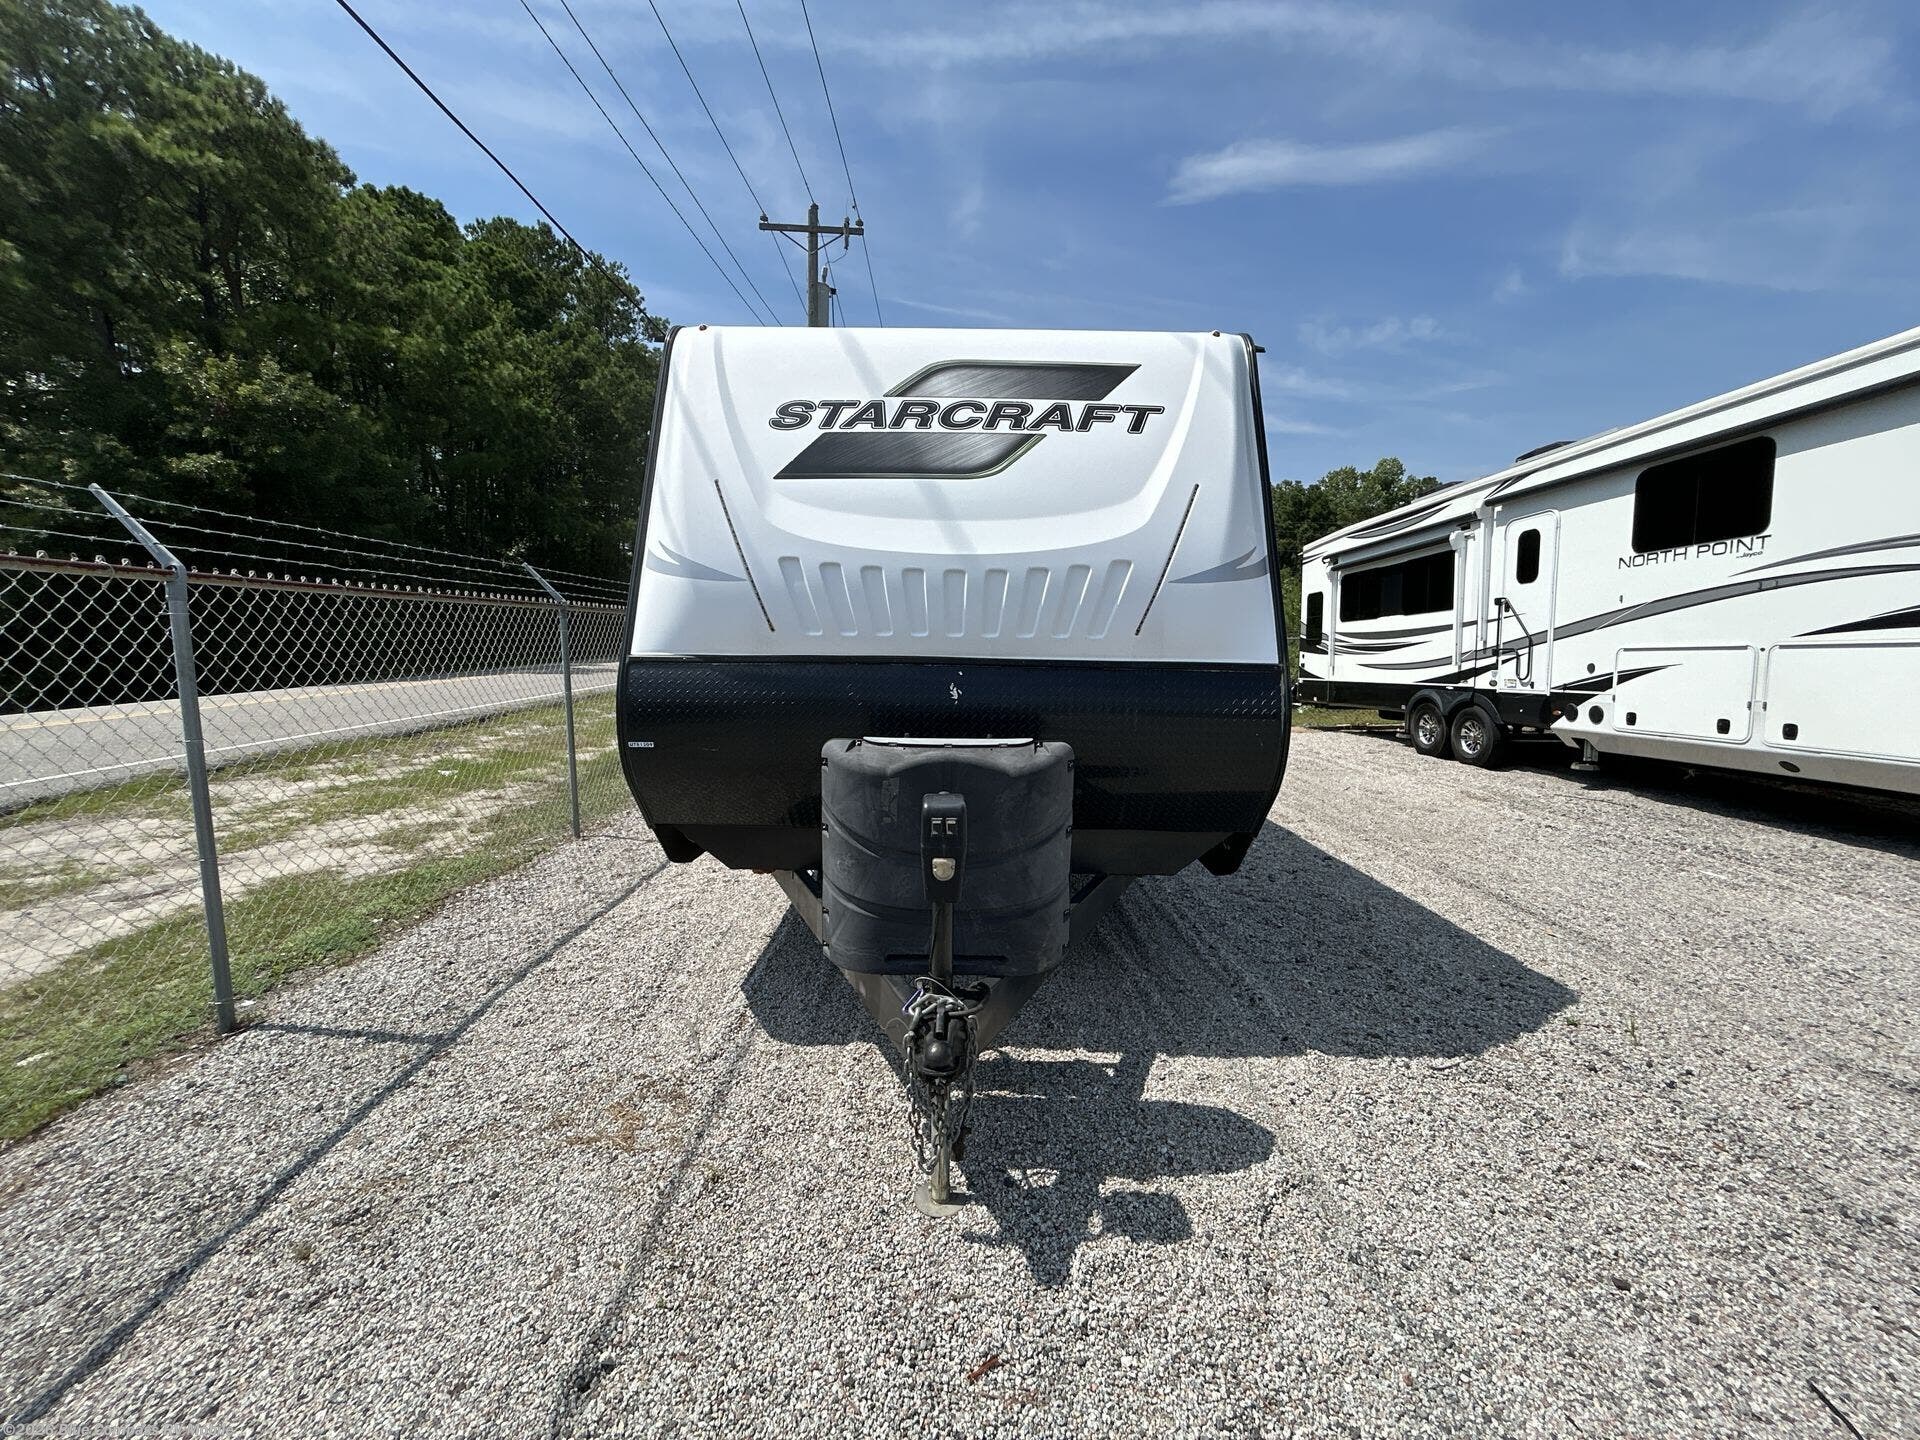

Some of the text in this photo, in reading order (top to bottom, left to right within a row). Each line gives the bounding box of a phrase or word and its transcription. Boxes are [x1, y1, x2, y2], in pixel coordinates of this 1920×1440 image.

[768, 399, 1165, 434] STARCRAFT
[1618, 534, 1772, 569] NORTH POINT
